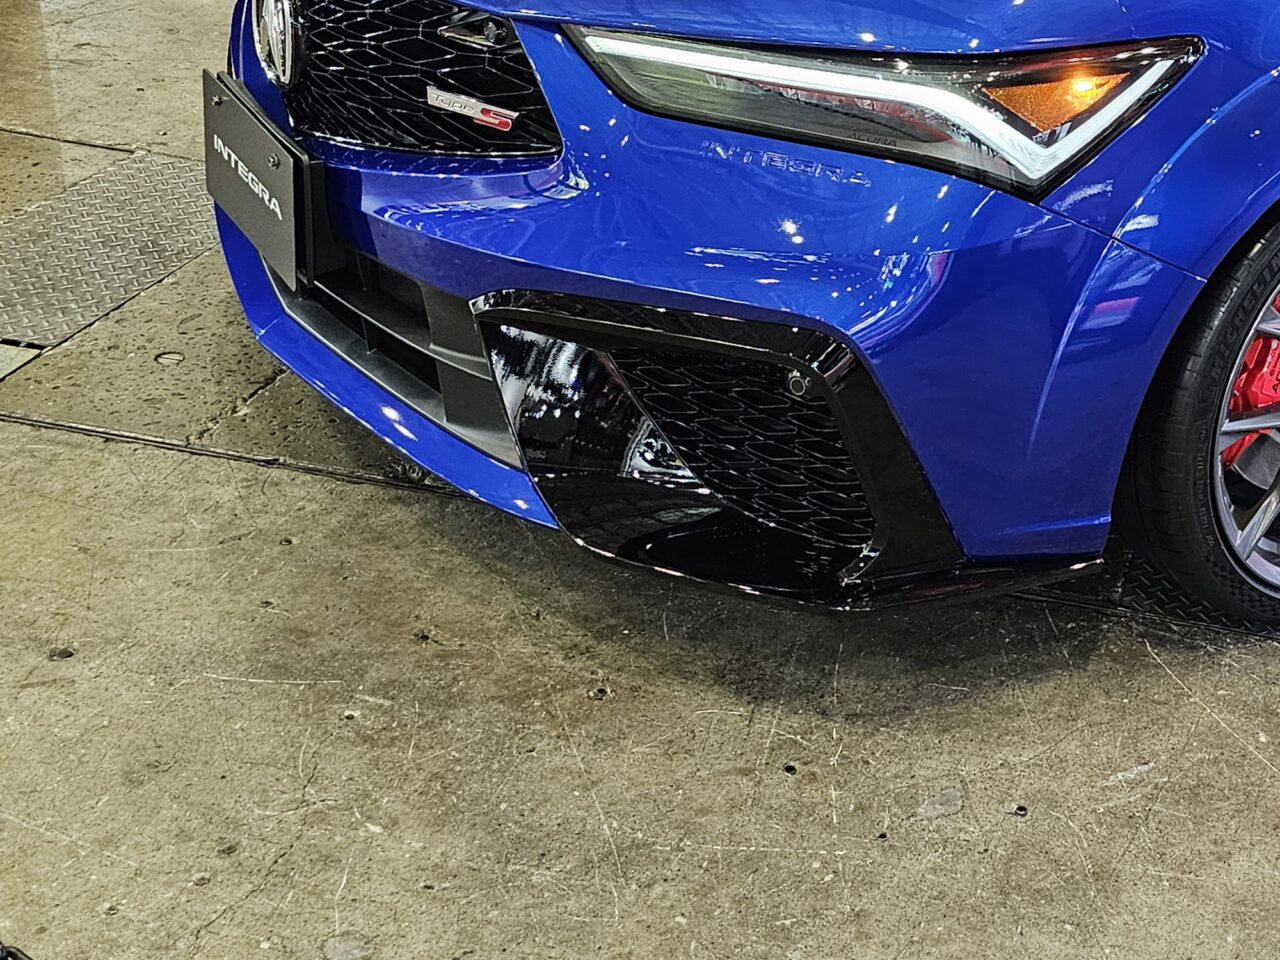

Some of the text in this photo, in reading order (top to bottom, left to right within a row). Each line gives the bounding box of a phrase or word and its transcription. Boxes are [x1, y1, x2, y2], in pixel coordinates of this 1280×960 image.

[430, 92, 520, 132] Type S
[213, 134, 283, 221] INTEGRA
